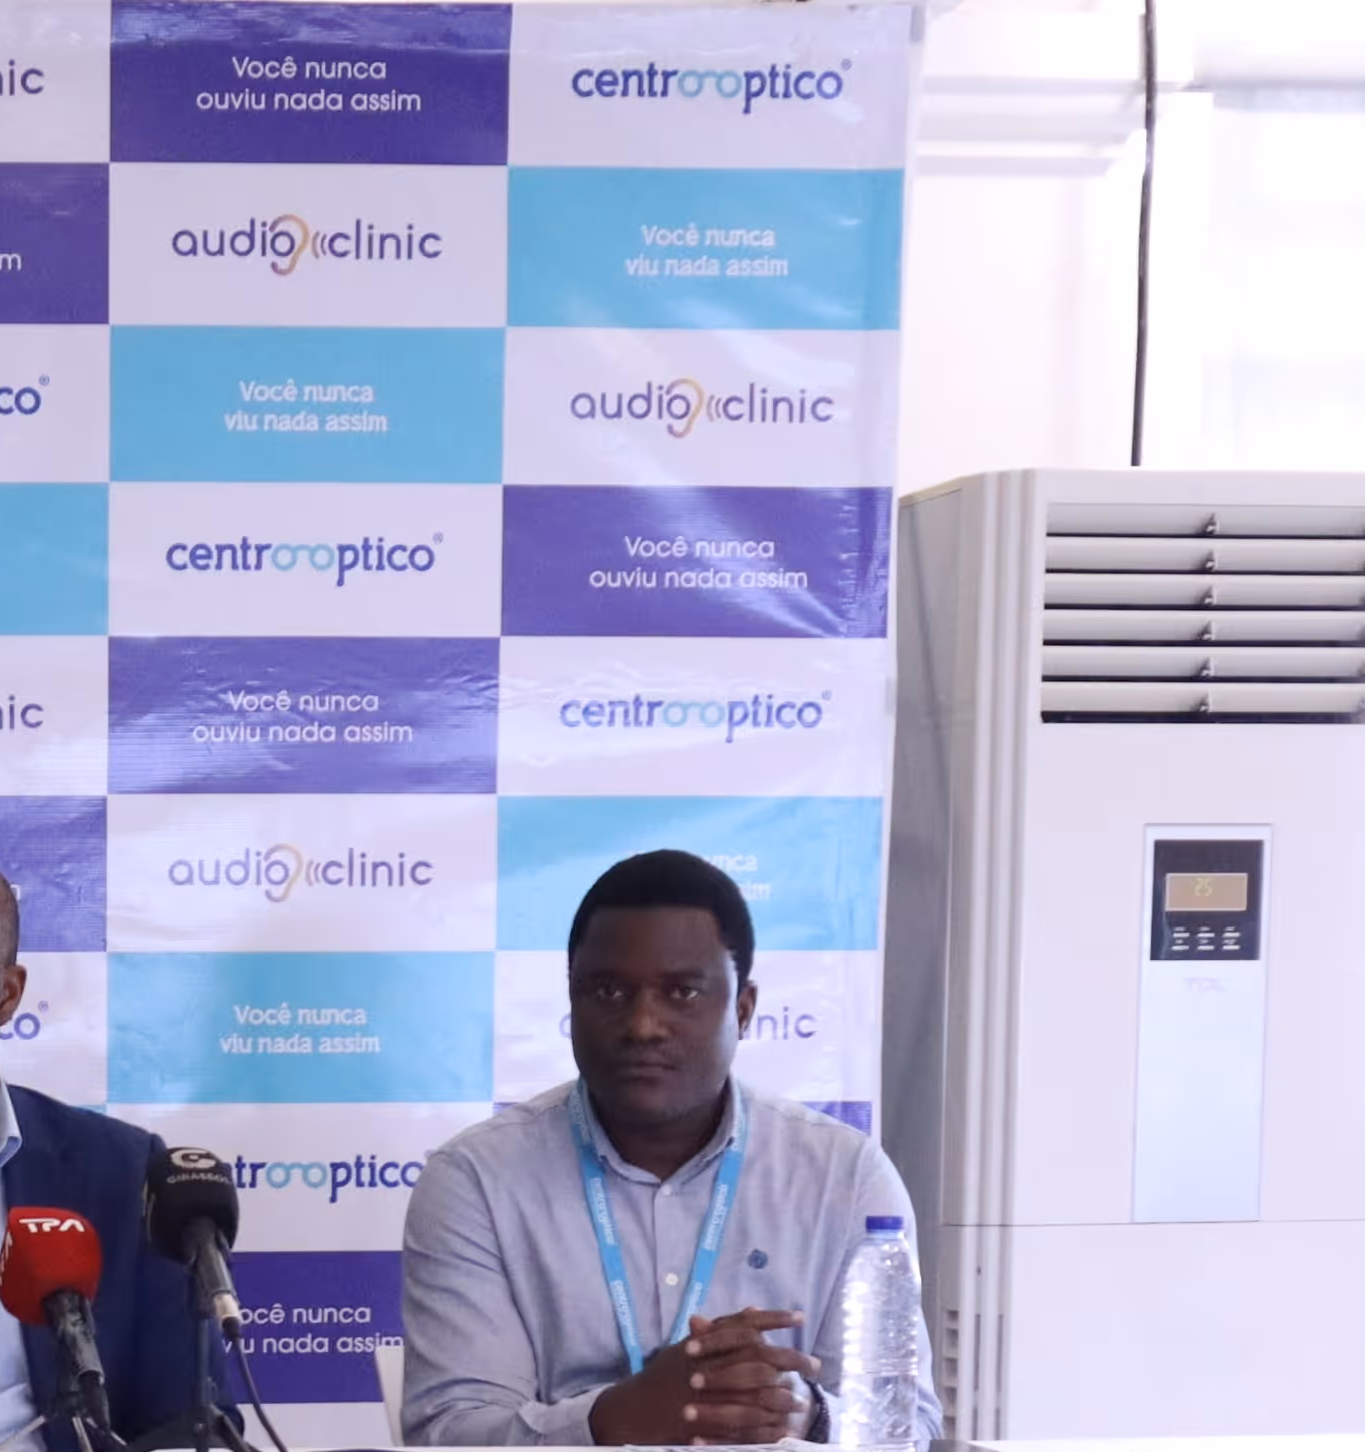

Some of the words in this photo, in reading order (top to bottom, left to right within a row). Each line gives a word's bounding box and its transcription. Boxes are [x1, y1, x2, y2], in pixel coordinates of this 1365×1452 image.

[231, 55, 298, 79] Você
[305, 61, 387, 80] nunca
[196, 88, 266, 110] ouviu
[274, 88, 343, 111] nada
[350, 89, 421, 112] assim
[640, 221, 699, 247] Você
[704, 228, 774, 247] nunca
[625, 252, 659, 276] viu
[664, 255, 720, 276] nada
[725, 255, 788, 277] assim
[239, 377, 298, 403] Você
[303, 384, 374, 403] nunca
[224, 409, 258, 432] viu
[263, 410, 319, 432] nada
[325, 409, 387, 432] assim
[623, 535, 688, 558] Você
[695, 540, 775, 559] nunca
[589, 566, 657, 589] ouviu
[664, 567, 731, 590] nada
[738, 566, 809, 590] assim
[227, 689, 292, 712] Você
[298, 694, 379, 713] nunca
[192, 721, 260, 744] ouviu
[268, 721, 336, 743] nada
[343, 721, 414, 744] assim
[233, 1001, 292, 1026] Você
[297, 1008, 365, 1025] nunca
[220, 1033, 253, 1054] viu
[258, 1033, 313, 1054] nada
[319, 1033, 381, 1054] assim
[19, 1217, 85, 1233] TPA
[239, 1302, 286, 1325] ocê
[292, 1306, 371, 1324] nunca
[262, 1332, 329, 1354] nada
